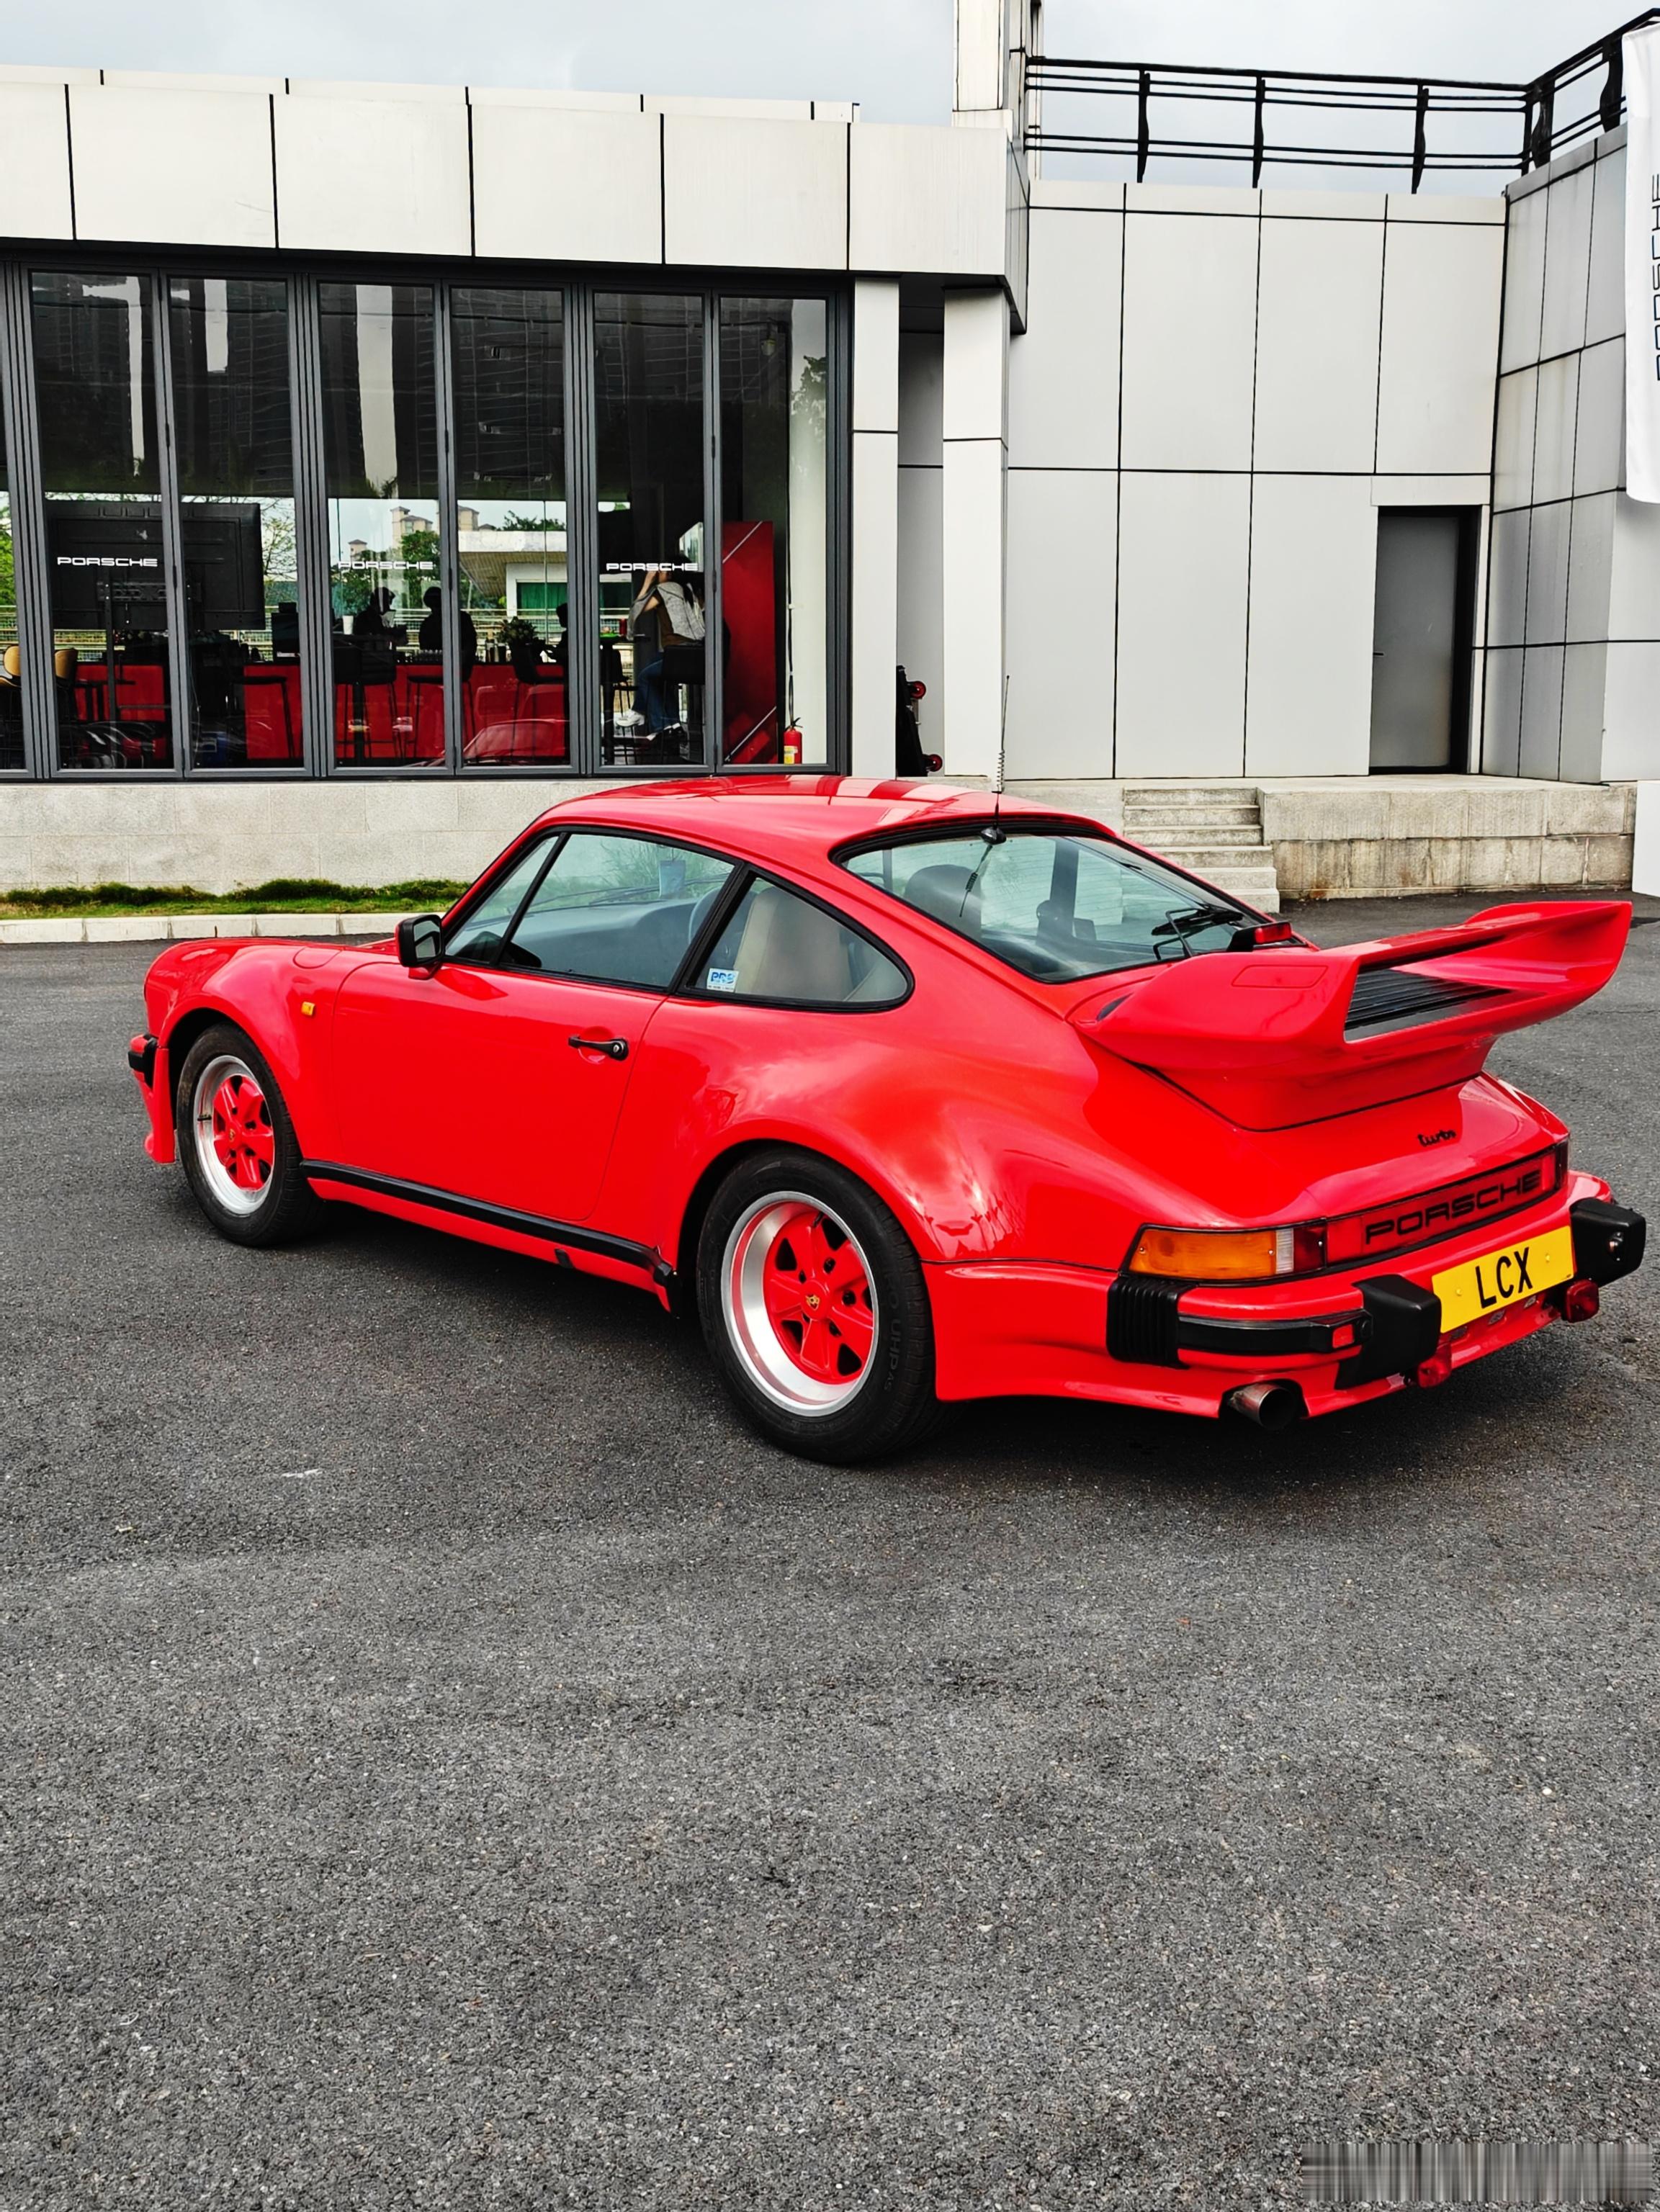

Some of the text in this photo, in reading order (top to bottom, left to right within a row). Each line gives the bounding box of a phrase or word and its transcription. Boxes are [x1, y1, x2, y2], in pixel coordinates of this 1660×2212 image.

[57, 557, 158, 567] PORSCHE
[338, 561, 434, 570] PORSCHE
[606, 562, 699, 572] PORSCHE
[1365, 1169, 1541, 1245] PORSCHE
[1475, 1246, 1533, 1308] LCX
